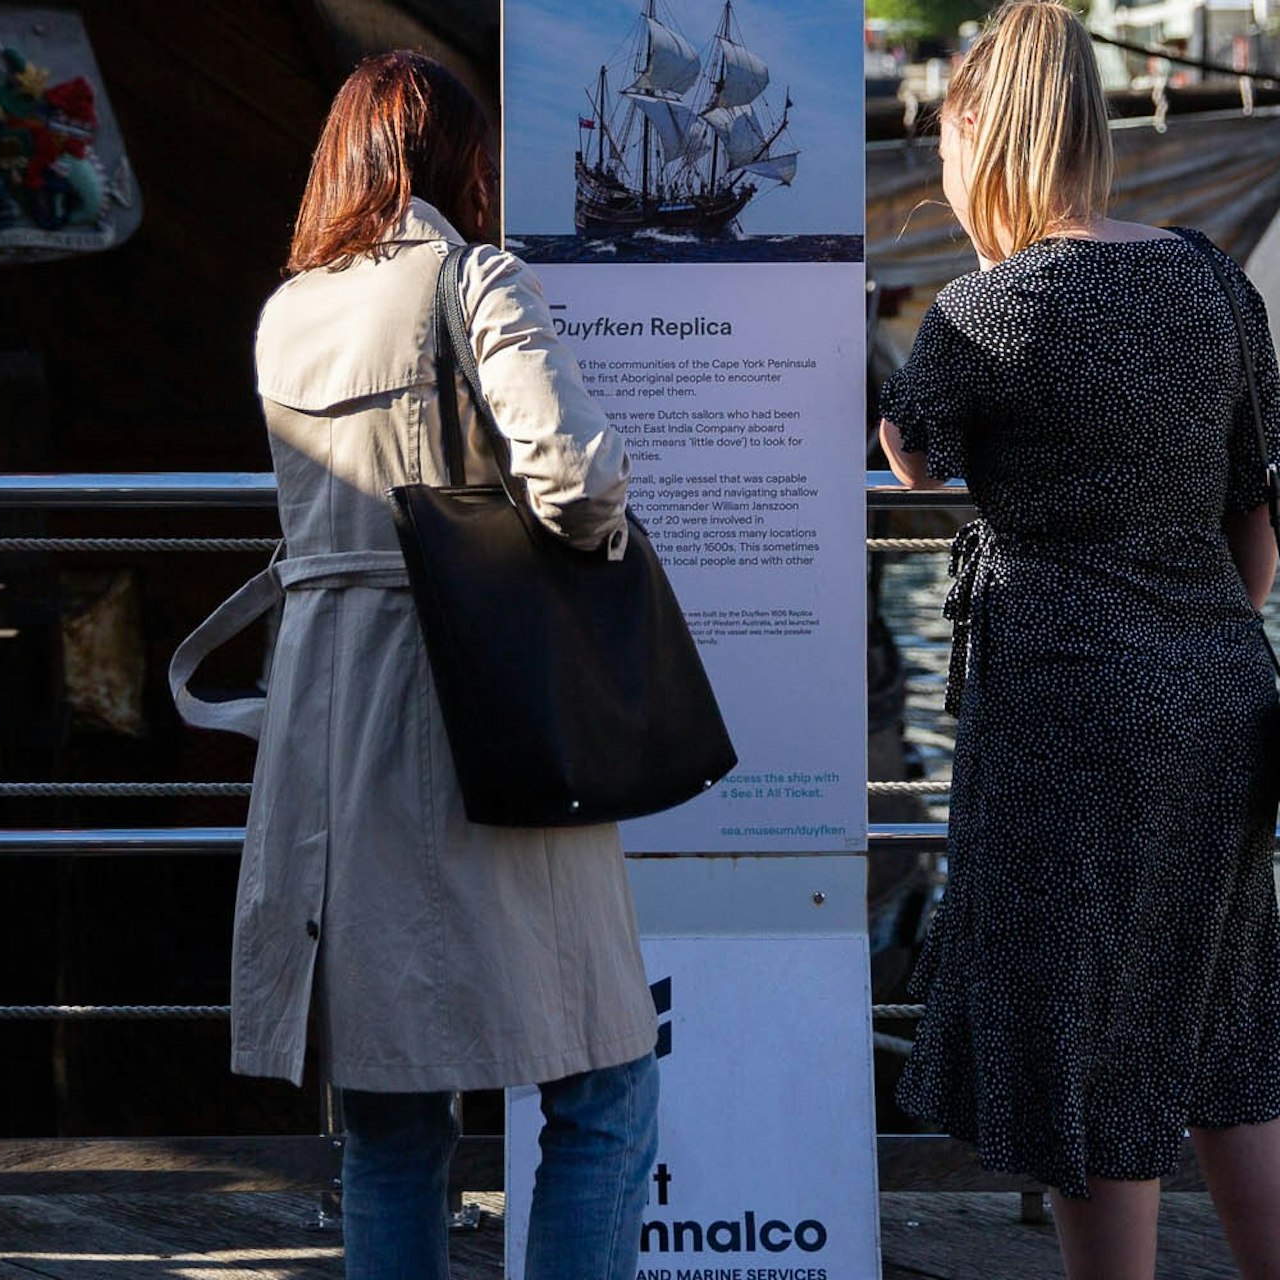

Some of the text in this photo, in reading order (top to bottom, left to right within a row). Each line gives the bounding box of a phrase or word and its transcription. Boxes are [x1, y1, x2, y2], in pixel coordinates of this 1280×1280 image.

[553, 317, 731, 340] Duyfken Replica
[589, 360, 606, 369] the
[607, 360, 676, 369] communities
[678, 360, 689, 368] of
[692, 360, 709, 368] the
[712, 359, 739, 369] Cape
[741, 360, 765, 368] York
[768, 359, 816, 368] Peninsula
[598, 373, 781, 384] first Aboriginal people to encounter
[616, 388, 635, 397] and
[638, 387, 664, 398] repel
[667, 387, 696, 396] them.
[629, 412, 655, 420] were
[658, 410, 689, 419] Dutch
[691, 410, 724, 419] sailors
[727, 410, 749, 419] who
[752, 410, 771, 419] had
[774, 410, 800, 419] been
[644, 423, 784, 434] East India Company aboard
[750, 438, 760, 446] to
[763, 437, 785, 446] look
[788, 437, 803, 446] for
[659, 474, 683, 486] agile
[686, 474, 717, 483] vessel
[719, 475, 740, 483] that
[766, 474, 807, 484] capable
[657, 487, 818, 499] voyages and navigating shallow
[646, 502, 710, 511] commander
[712, 502, 749, 510] William
[652, 516, 663, 525] of
[665, 515, 679, 525] 20
[710, 515, 752, 524] involved
[755, 515, 764, 524] in
[663, 529, 700, 540] trading
[739, 531, 767, 539] many
[770, 528, 817, 538] locations
[656, 543, 673, 552] the
[676, 543, 701, 553] early
[739, 542, 760, 551] This
[763, 542, 819, 551] sometimes
[673, 556, 698, 566] local
[700, 556, 736, 567] people
[738, 556, 758, 565] and
[761, 556, 783, 565] with
[786, 556, 814, 565] other
[765, 772, 785, 783] the
